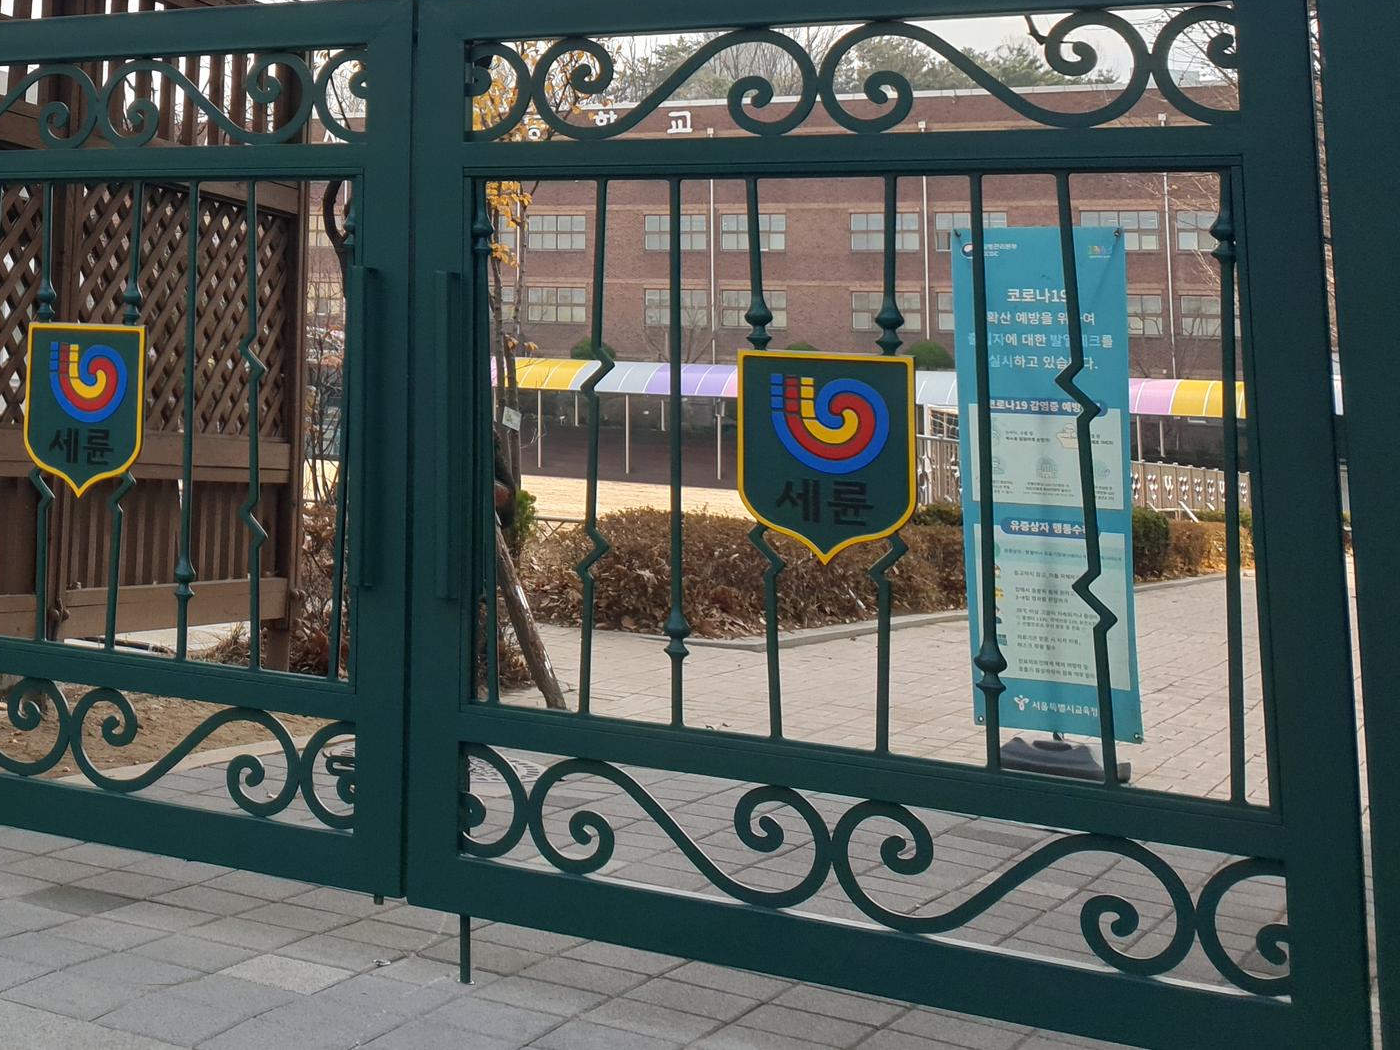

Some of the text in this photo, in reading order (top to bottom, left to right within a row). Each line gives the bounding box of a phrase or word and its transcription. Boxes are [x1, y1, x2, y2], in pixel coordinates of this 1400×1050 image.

[987, 311, 1096, 326] 확산 예방을 위여
[1022, 333, 1046, 348] 대한
[989, 354, 1038, 368] 실시하고
[50, 427, 114, 466] 세륜
[775, 477, 874, 527] 세륜
[1010, 520, 1049, 534] 유증상자
